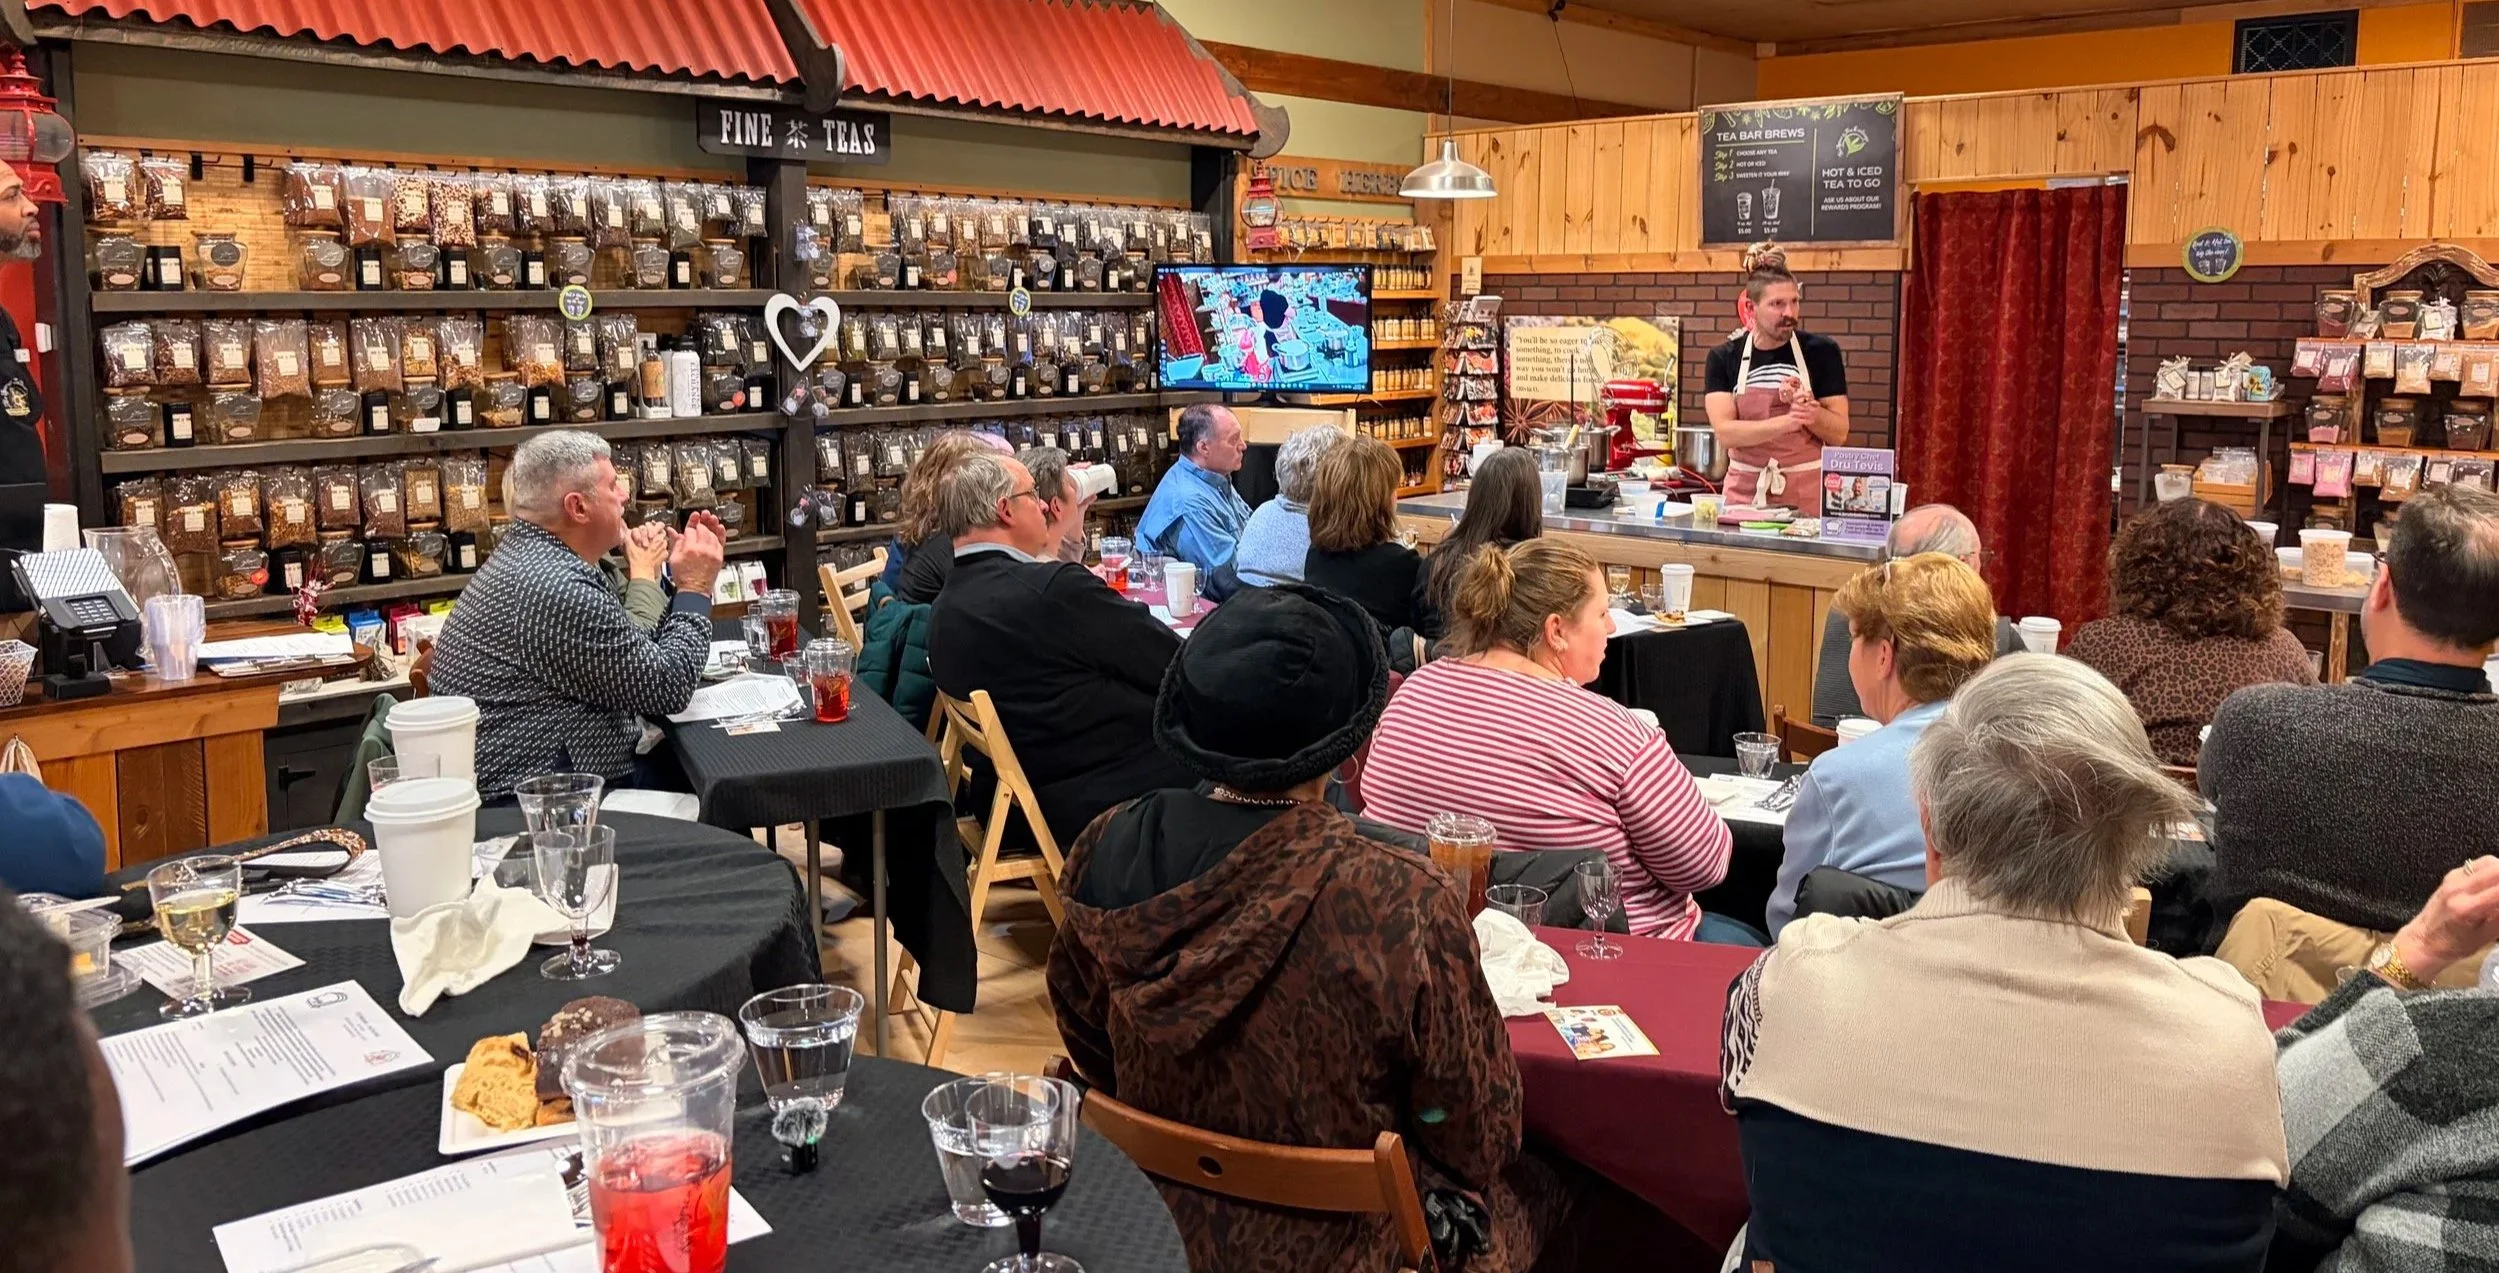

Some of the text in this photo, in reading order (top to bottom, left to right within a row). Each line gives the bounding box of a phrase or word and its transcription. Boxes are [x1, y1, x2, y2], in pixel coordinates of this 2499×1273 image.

[720, 109, 876, 155] FINE 茶 TEAS
[1716, 128, 1805, 142] TEA BAR BREWS
[1729, 148, 1734, 157] 1
[1729, 160, 1734, 169] 2
[1729, 171, 1734, 180] 3
[1822, 166, 1882, 177] HOT & ICED
[1823, 178, 1881, 189] TEA TO GO
[1539, 336, 1548, 344] be
[1559, 338, 1578, 346] eager
[1516, 346, 1553, 355] something,
[1562, 346, 1580, 354] cook
[1516, 356, 1553, 364] something,
[1554, 355, 1578, 364] theres
[1545, 365, 1565, 373] won't
[1529, 374, 1548, 382] make
[690, 362, 698, 409] EXCHANGE
[1834, 451, 1880, 461] Pastry Chef
[1830, 459, 1884, 471] Dru Tevis
